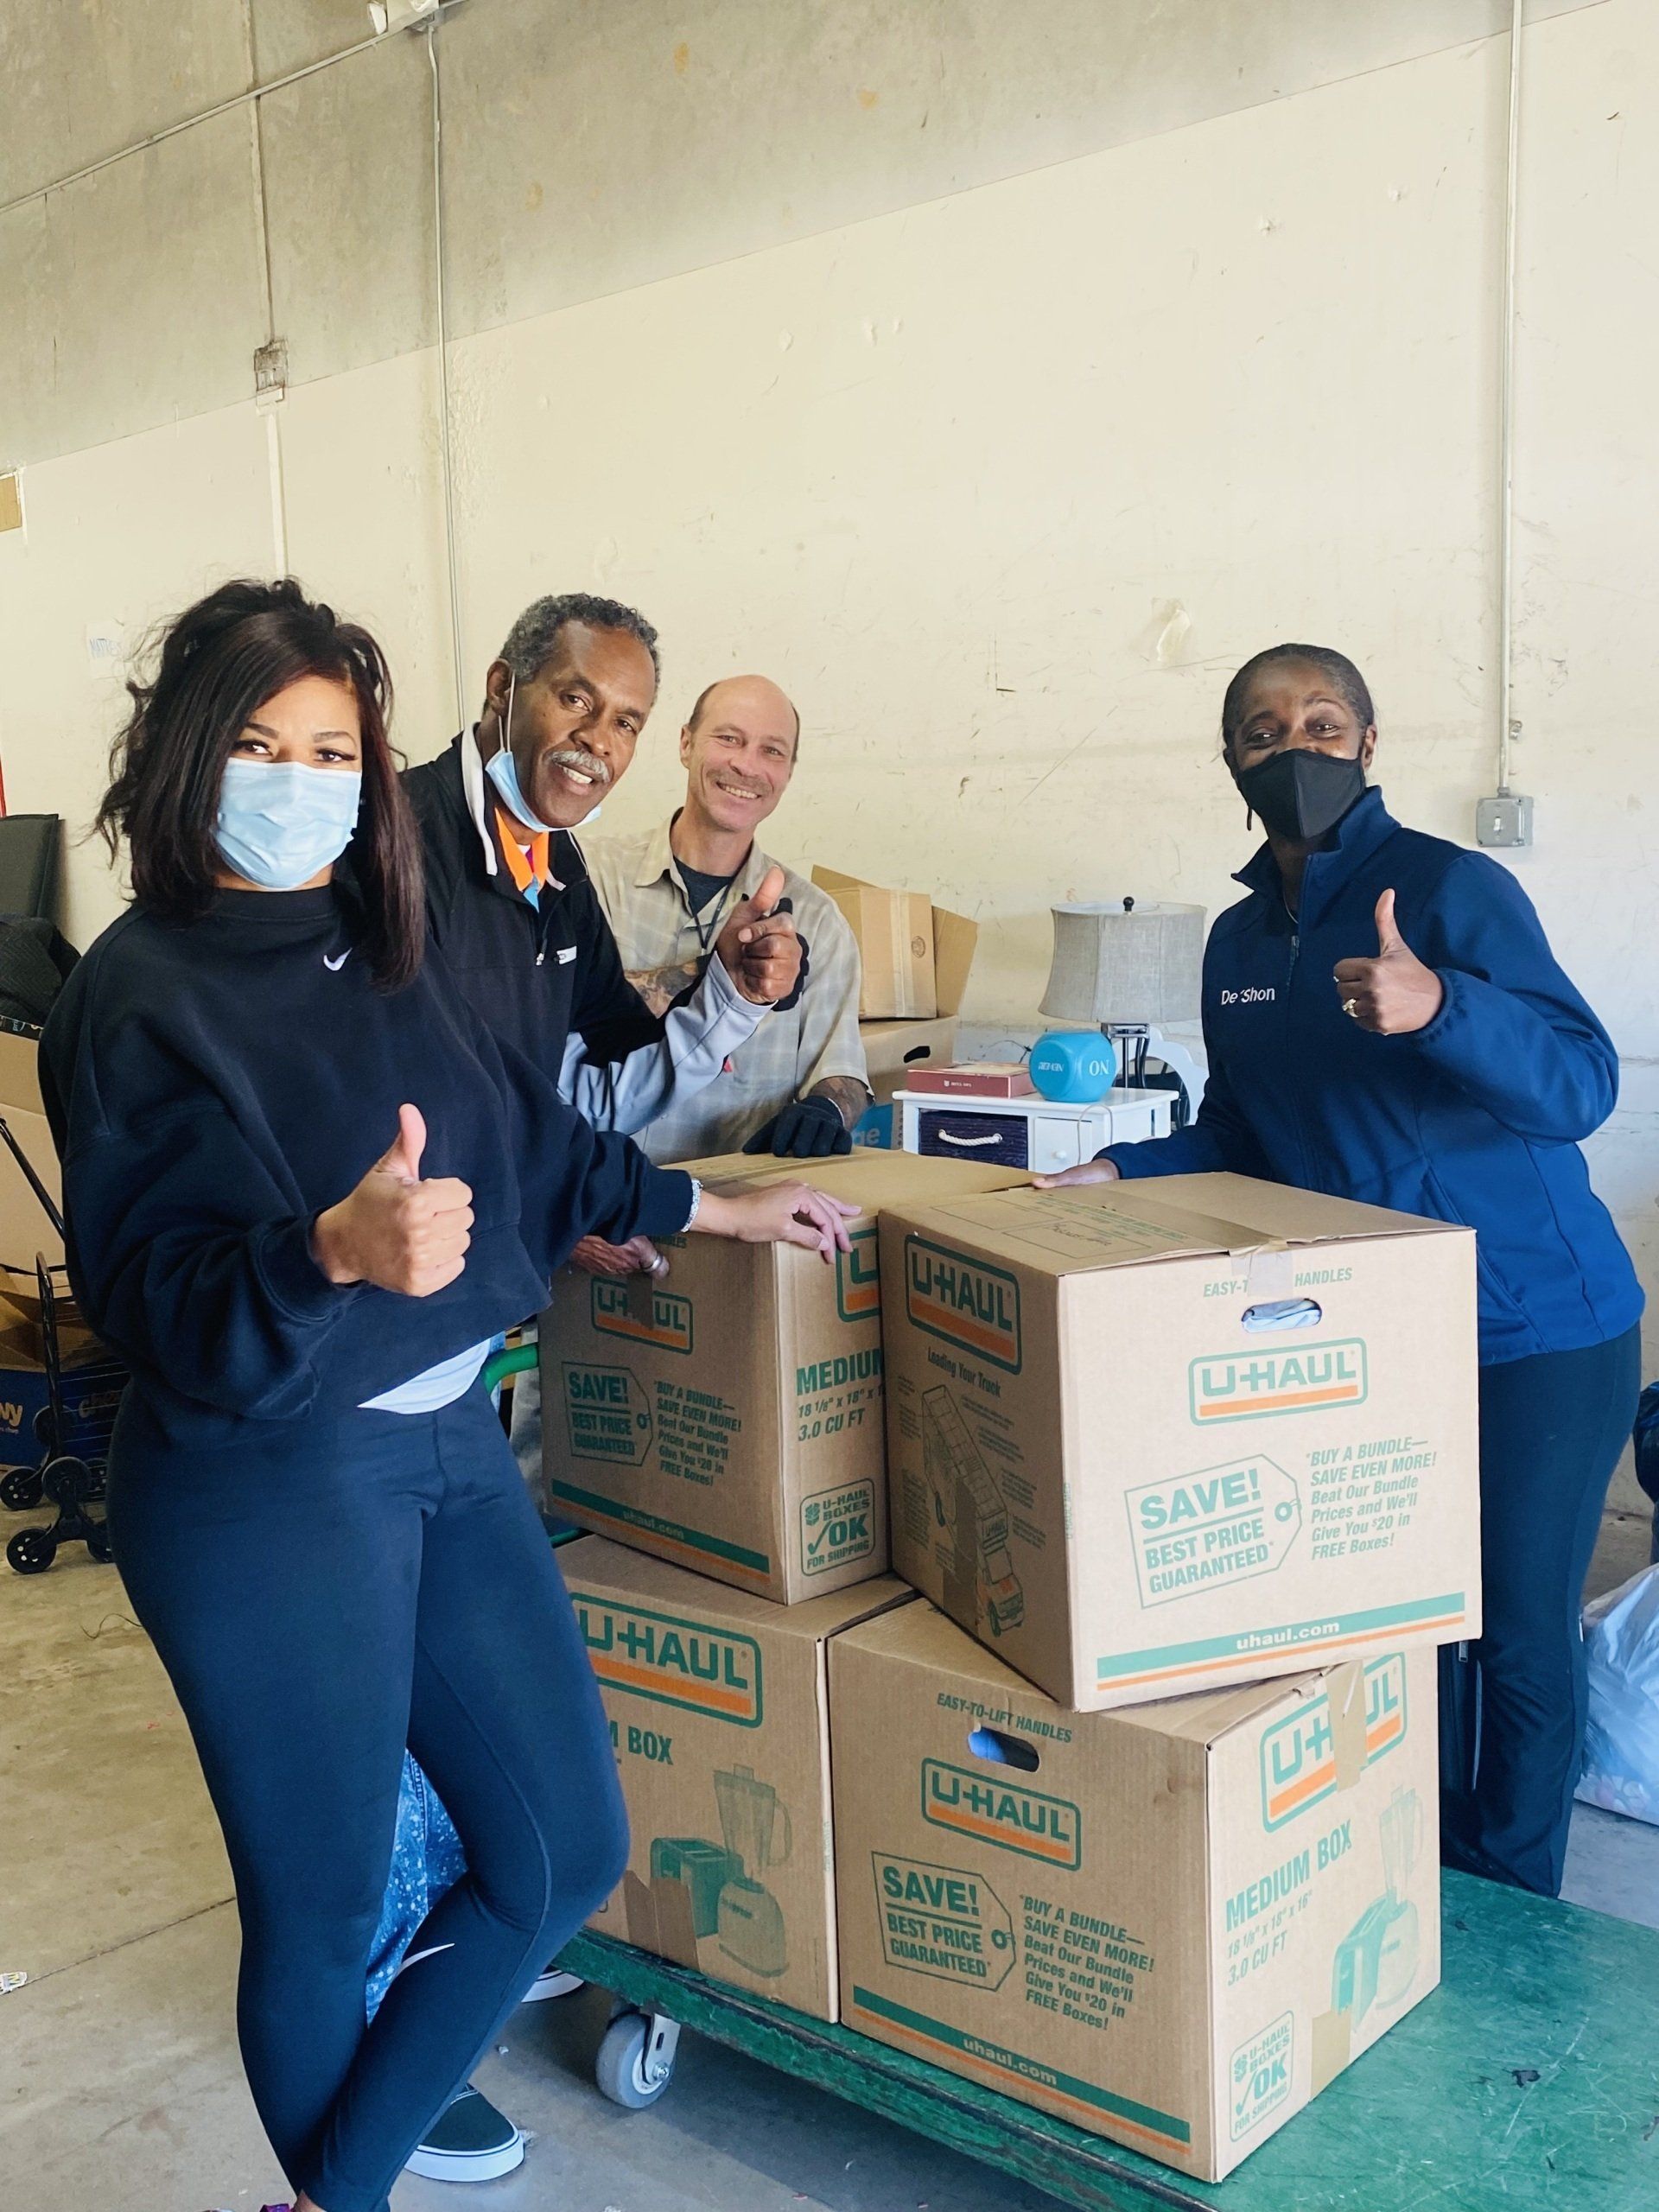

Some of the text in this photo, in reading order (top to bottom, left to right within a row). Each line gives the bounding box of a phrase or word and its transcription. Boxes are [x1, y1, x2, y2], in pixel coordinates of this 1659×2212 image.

[911, 1251, 1014, 1332] U-HAUL
[1294, 1267, 1353, 1287] HANDLES
[569, 1371, 629, 1404] SAVE!
[928, 1346, 1001, 1398] Loading Your Truck
[1202, 1351, 1357, 1397] U-HAUL
[676, 1387, 683, 1399] A
[798, 1403, 812, 1418] 18
[572, 1412, 632, 1435] BEST PRICE
[657, 1398, 742, 1433] SAVE EVEN MORE!
[658, 1414, 728, 1445] Beat Our Bundle
[798, 1408, 866, 1442] 3.0 CU FT
[658, 1429, 684, 1447] Prices
[687, 1439, 703, 1453] and
[1343, 1446, 1353, 1462] A
[658, 1445, 678, 1460] Give
[680, 1451, 696, 1466] You
[715, 1462, 724, 1474] in
[660, 1460, 714, 1487] FREE Boxes!
[1311, 1452, 1437, 1487] SAVE EVEN MORE!
[823, 1489, 870, 1510] U-HAUL
[1140, 1468, 1262, 1529] SAVE!
[1311, 1475, 1419, 1505] Beat Our Bundle
[623, 1510, 684, 1541] uhaul.com
[823, 1498, 871, 1522] BOXES
[1312, 1492, 1418, 1524] Prices and We'll
[829, 1513, 868, 1547] OK
[1145, 1517, 1264, 1570] BEST PRICE
[1312, 1513, 1411, 1542] Give You $20 in
[807, 1540, 870, 1570] FOR SHIPPING
[1312, 1532, 1395, 1560] FREE Boxes!
[579, 1609, 748, 1690] U-HAUL
[1236, 1622, 1339, 1649] uhaul.com
[937, 1693, 1072, 1744] EASY-TO-LIFT HANDLES
[627, 1726, 674, 1765] BOX
[932, 1771, 1070, 1842] U-HAUL
[883, 1866, 980, 1916] SAVE!
[1225, 1818, 1353, 1933] MEDIUM BOX
[887, 1912, 982, 1954] BEST PRICE
[1054, 1908, 1065, 1923] A
[1024, 1915, 1154, 1973] SAVE EVEN MORE!
[1024, 1935, 1135, 1985] Beat Our Bundle
[1227, 1943, 1241, 1960] 18
[1227, 1929, 1288, 1986] 3.0 CU FT
[1024, 1953, 1134, 2003] Prices and We'll
[1026, 1971, 1125, 2018] Give You $20 in
[1026, 1988, 1109, 2031] FREE Boxes!
[1249, 2024, 1290, 2060] U-HAUL
[1249, 2034, 1290, 2074] BOXES
[963, 2038, 1057, 2086] uhaul.com
[1254, 2050, 1287, 2100] OK
[1234, 2082, 1287, 2134] FOR SHIPPING
